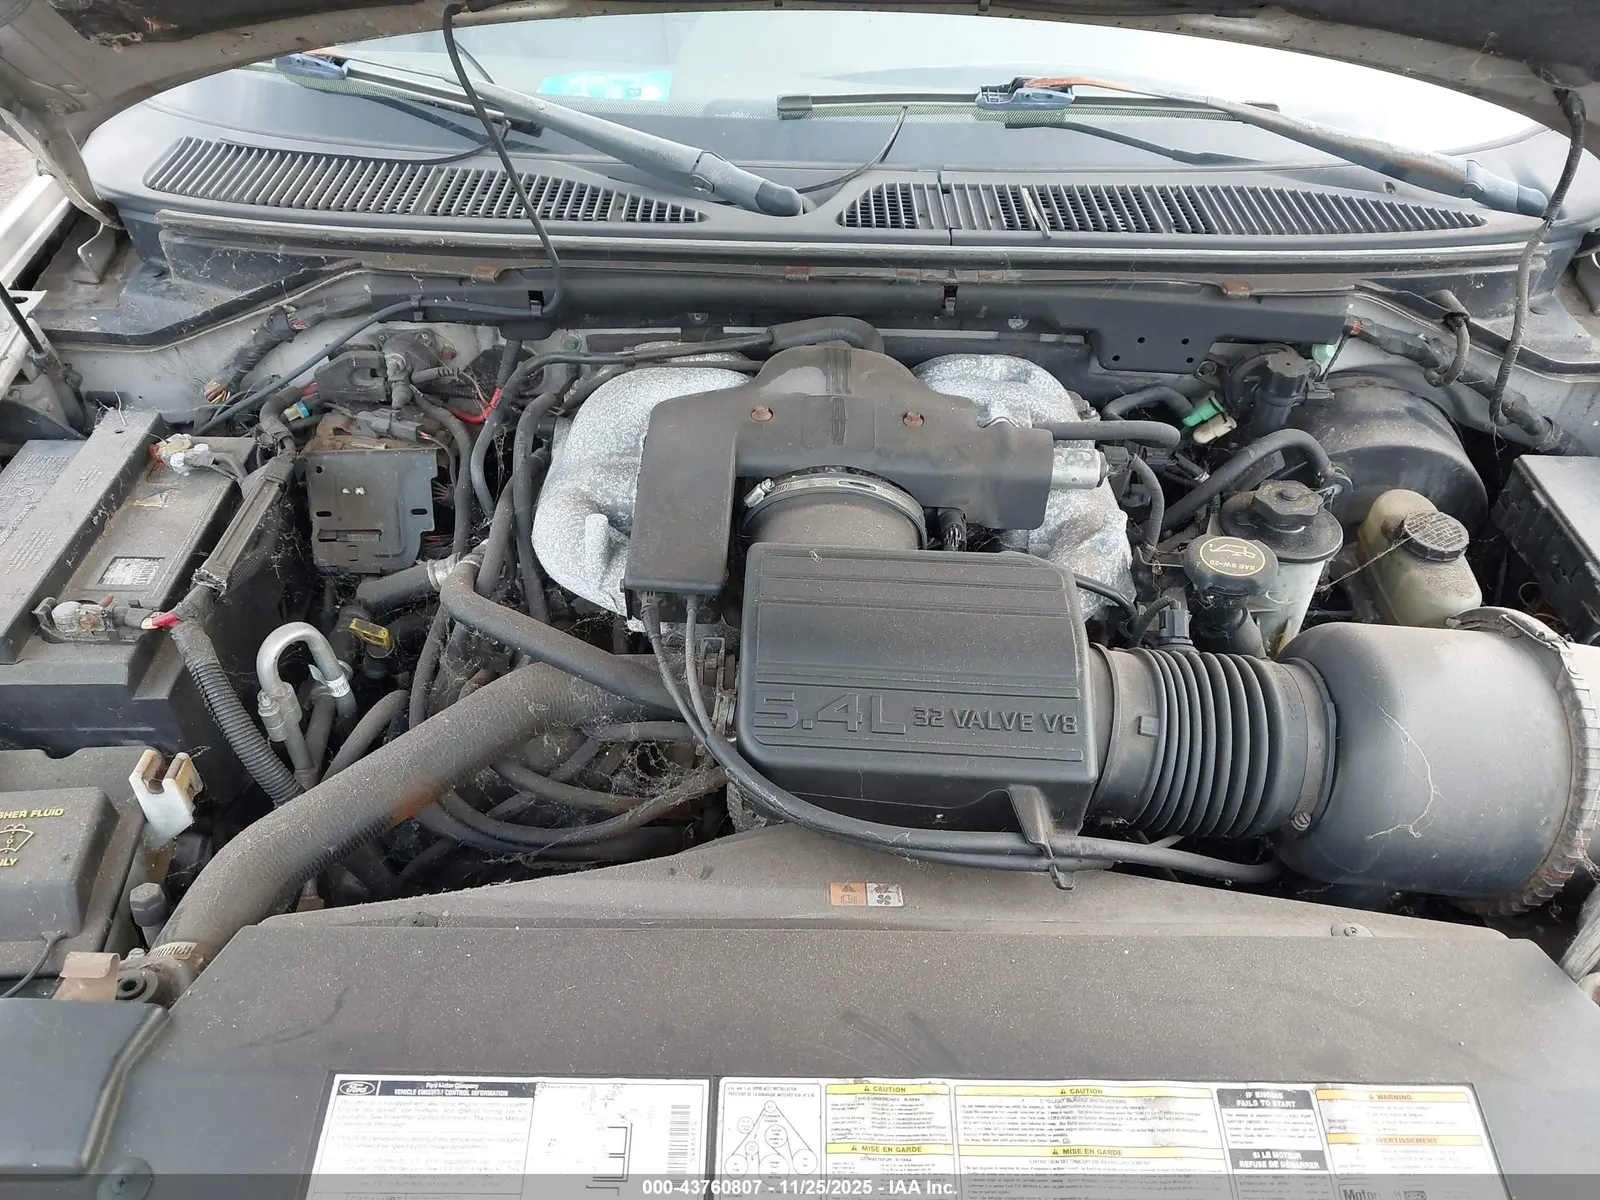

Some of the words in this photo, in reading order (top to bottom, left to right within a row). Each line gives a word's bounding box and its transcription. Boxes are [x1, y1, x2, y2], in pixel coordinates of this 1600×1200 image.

[754, 691, 907, 735] 5.4L
[913, 706, 945, 728] 32
[951, 707, 1035, 733] VALVE
[1039, 713, 1078, 734] V8
[30, 808, 64, 818] FLUID
[346, 1083, 368, 1093] Ford
[1245, 1091, 1254, 1099] IF
[1271, 1100, 1296, 1108] START
[1239, 1160, 1267, 1168] REFUSE
[1268, 1160, 1279, 1168] DE
